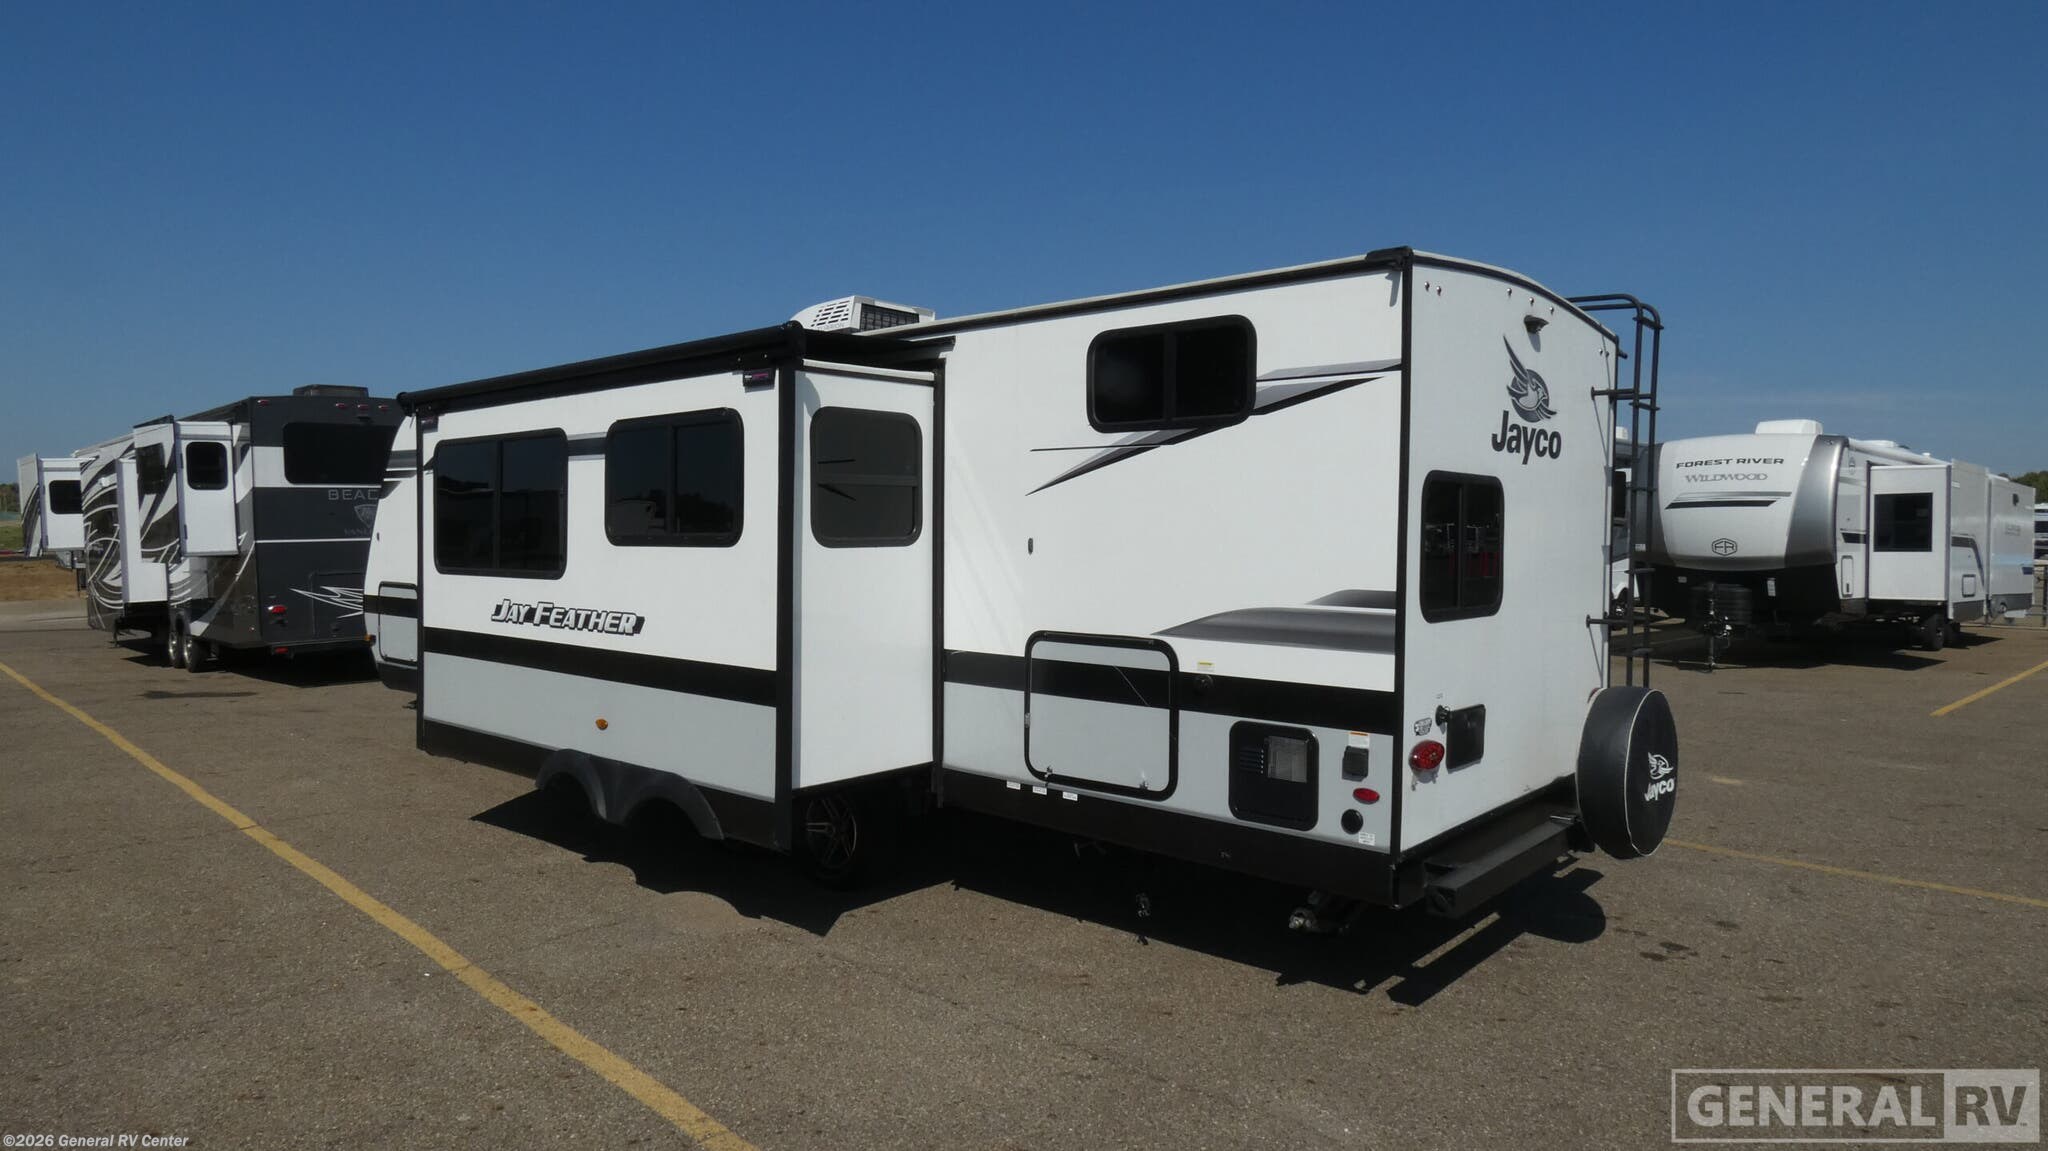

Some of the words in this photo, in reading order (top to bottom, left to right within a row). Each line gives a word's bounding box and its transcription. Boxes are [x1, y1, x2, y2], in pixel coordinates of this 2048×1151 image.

[1491, 409, 1562, 465] Jayco
[1676, 458, 1733, 469] FOREST
[1736, 457, 1785, 465] RIVER
[1684, 472, 1769, 483] WILDWOOD
[533, 601, 642, 636] FEATHER
